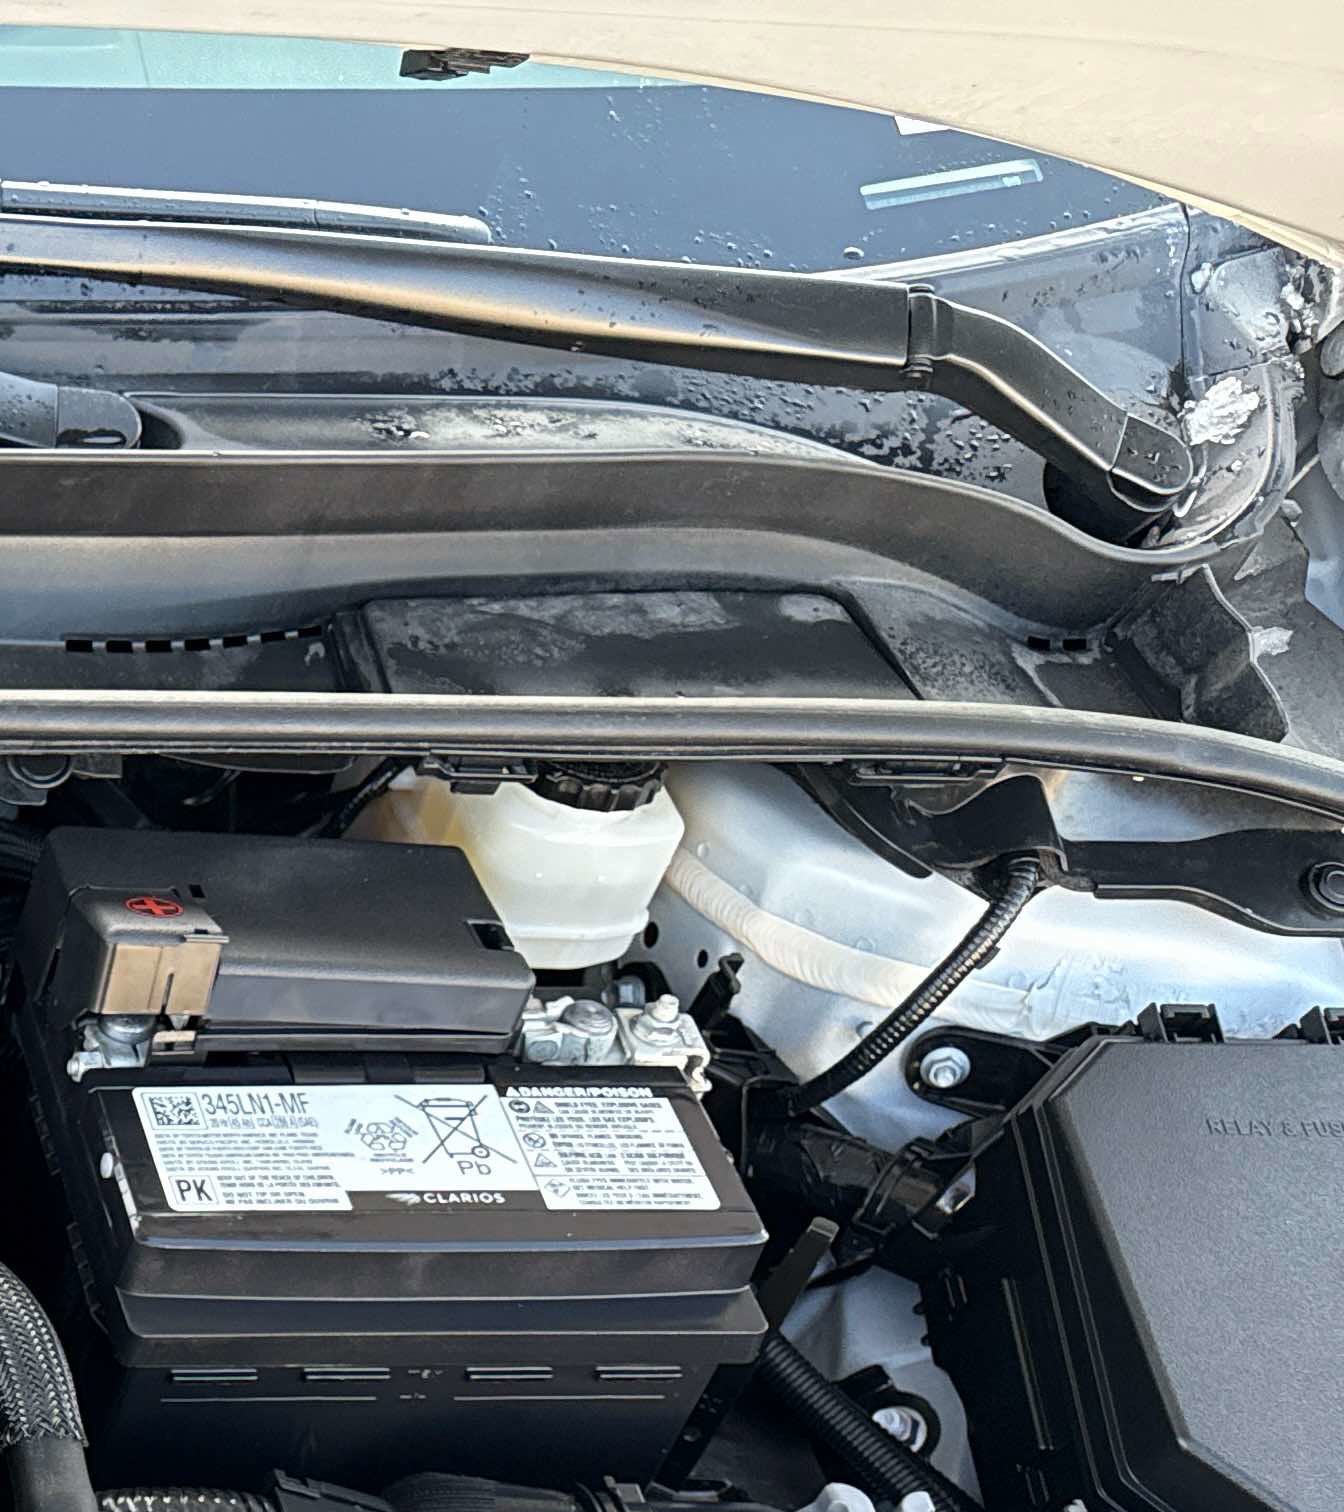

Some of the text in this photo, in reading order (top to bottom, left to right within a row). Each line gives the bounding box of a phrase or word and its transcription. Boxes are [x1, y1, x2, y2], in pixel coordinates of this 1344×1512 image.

[201, 1092, 309, 1115] 345LN1-MF
[1206, 1118, 1273, 1136] RELAY
[457, 1160, 492, 1175] Pb
[175, 1178, 212, 1202] PK
[423, 1192, 506, 1204] CLARIOS
